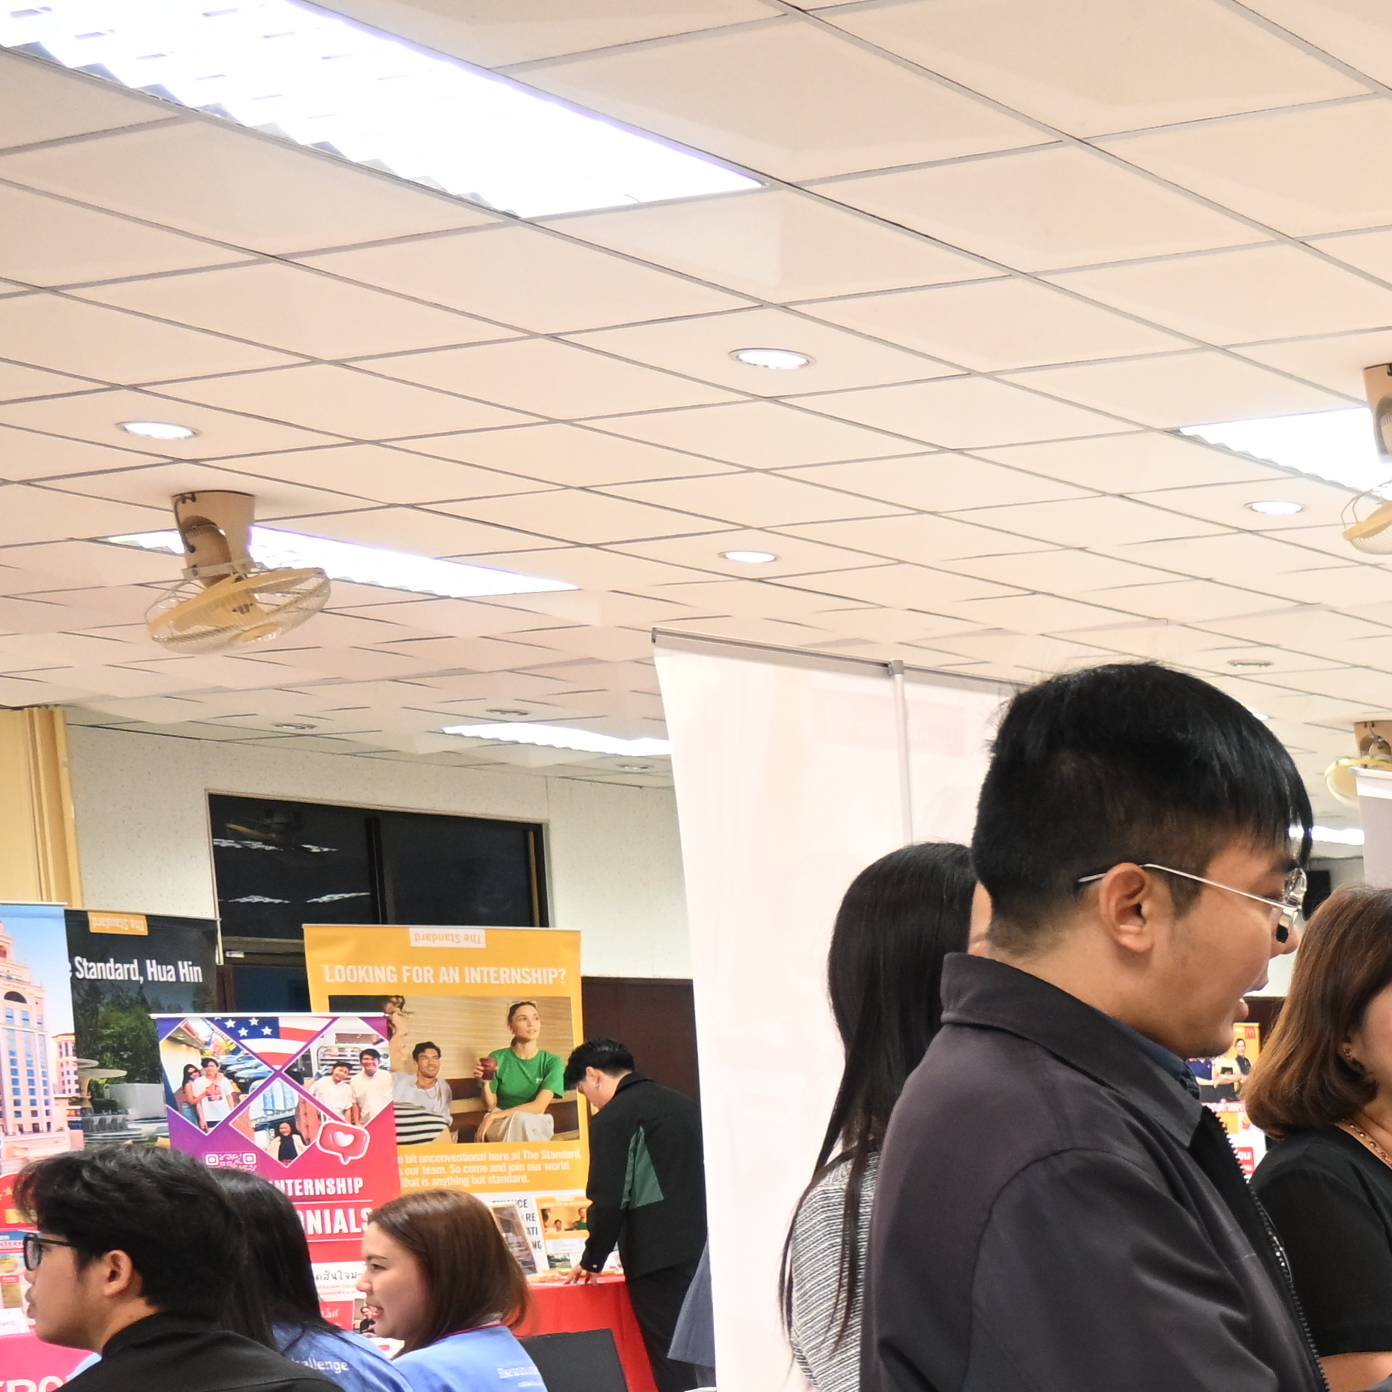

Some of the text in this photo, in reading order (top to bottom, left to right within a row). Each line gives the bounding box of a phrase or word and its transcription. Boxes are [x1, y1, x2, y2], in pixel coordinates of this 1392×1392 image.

[414, 933, 482, 945] The Standard
[75, 956, 144, 984] Standard,
[147, 959, 175, 983] Hua
[179, 961, 203, 983] Hin
[324, 965, 566, 985] LOOKING FOR AN INTERNSHIP?
[406, 1154, 417, 1163] bit
[420, 1152, 486, 1163] unconventional
[489, 1151, 508, 1161] here
[511, 1152, 520, 1160] at
[523, 1151, 539, 1160] The
[541, 1149, 582, 1159] Standard.
[405, 1167, 419, 1175] our
[422, 1165, 447, 1175] team.
[450, 1164, 460, 1174] So
[463, 1165, 487, 1174] come
[490, 1163, 507, 1172] and
[509, 1162, 525, 1174] join
[527, 1163, 542, 1172] our
[544, 1161, 569, 1171] world
[402, 1174, 530, 1188] that is anything but standard.
